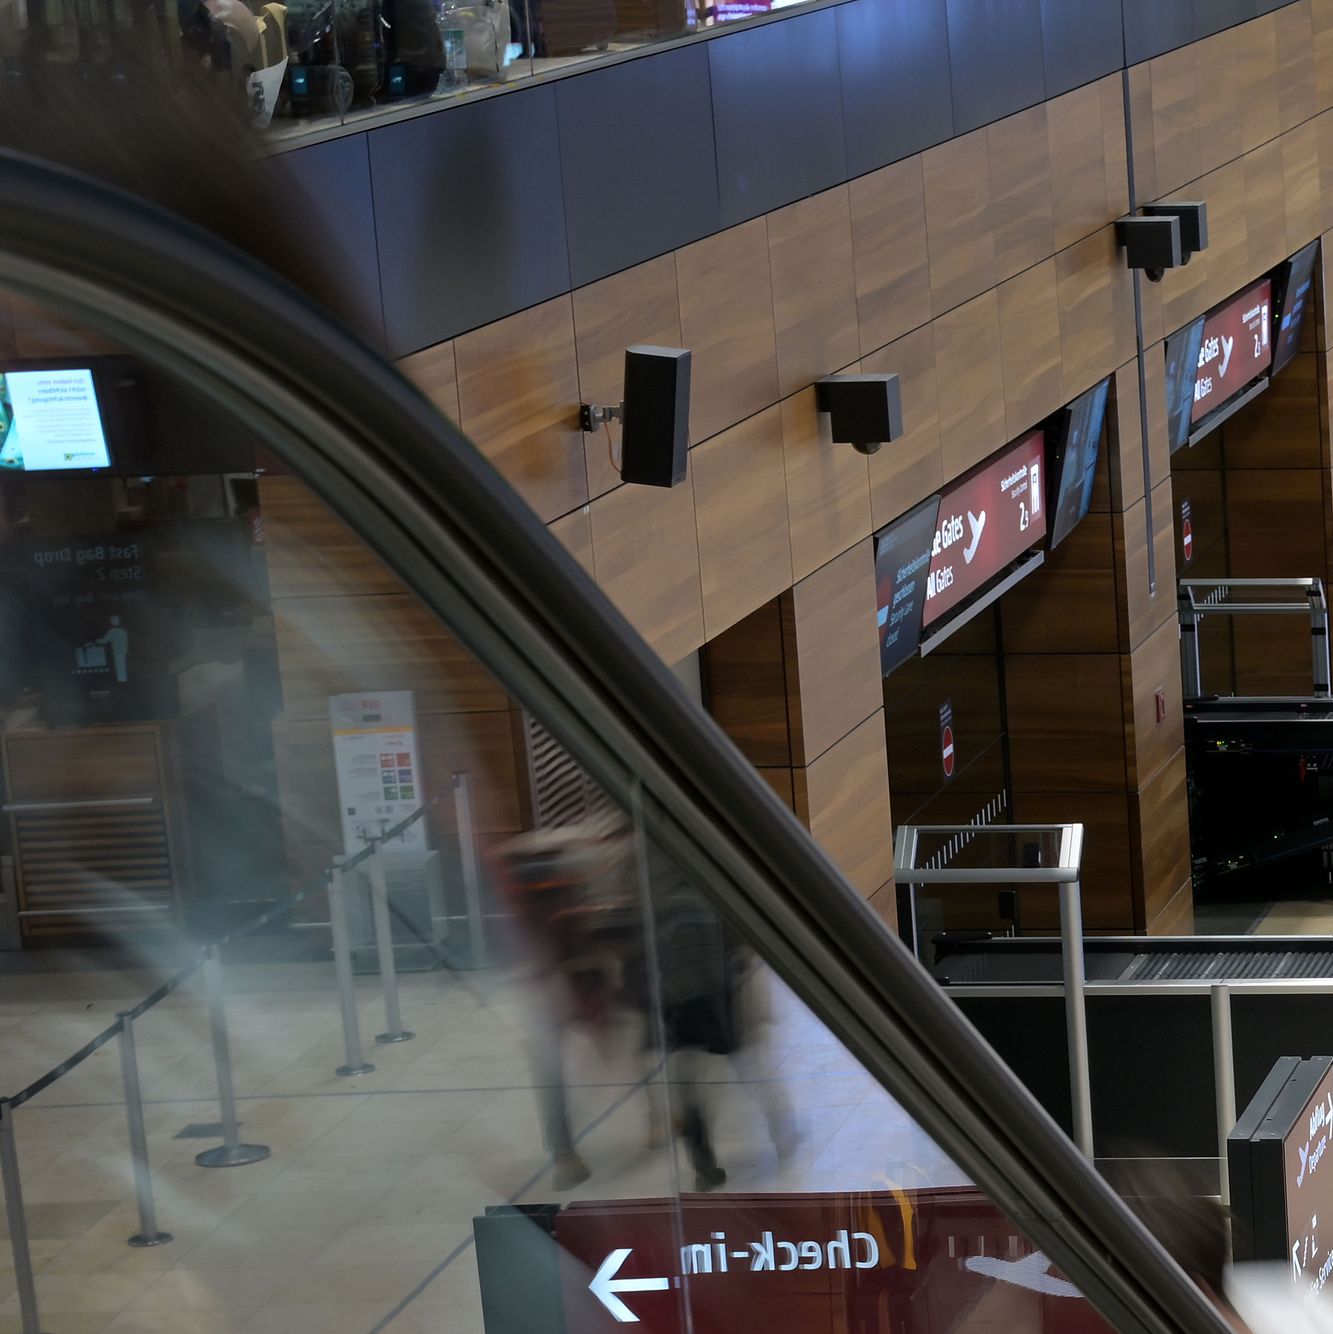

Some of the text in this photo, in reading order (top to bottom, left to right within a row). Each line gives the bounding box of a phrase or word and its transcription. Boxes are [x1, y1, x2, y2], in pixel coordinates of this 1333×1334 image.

[942, 515, 963, 549] Gates
[939, 565, 954, 593] Gates
[1310, 1102, 1325, 1141] Abflug
